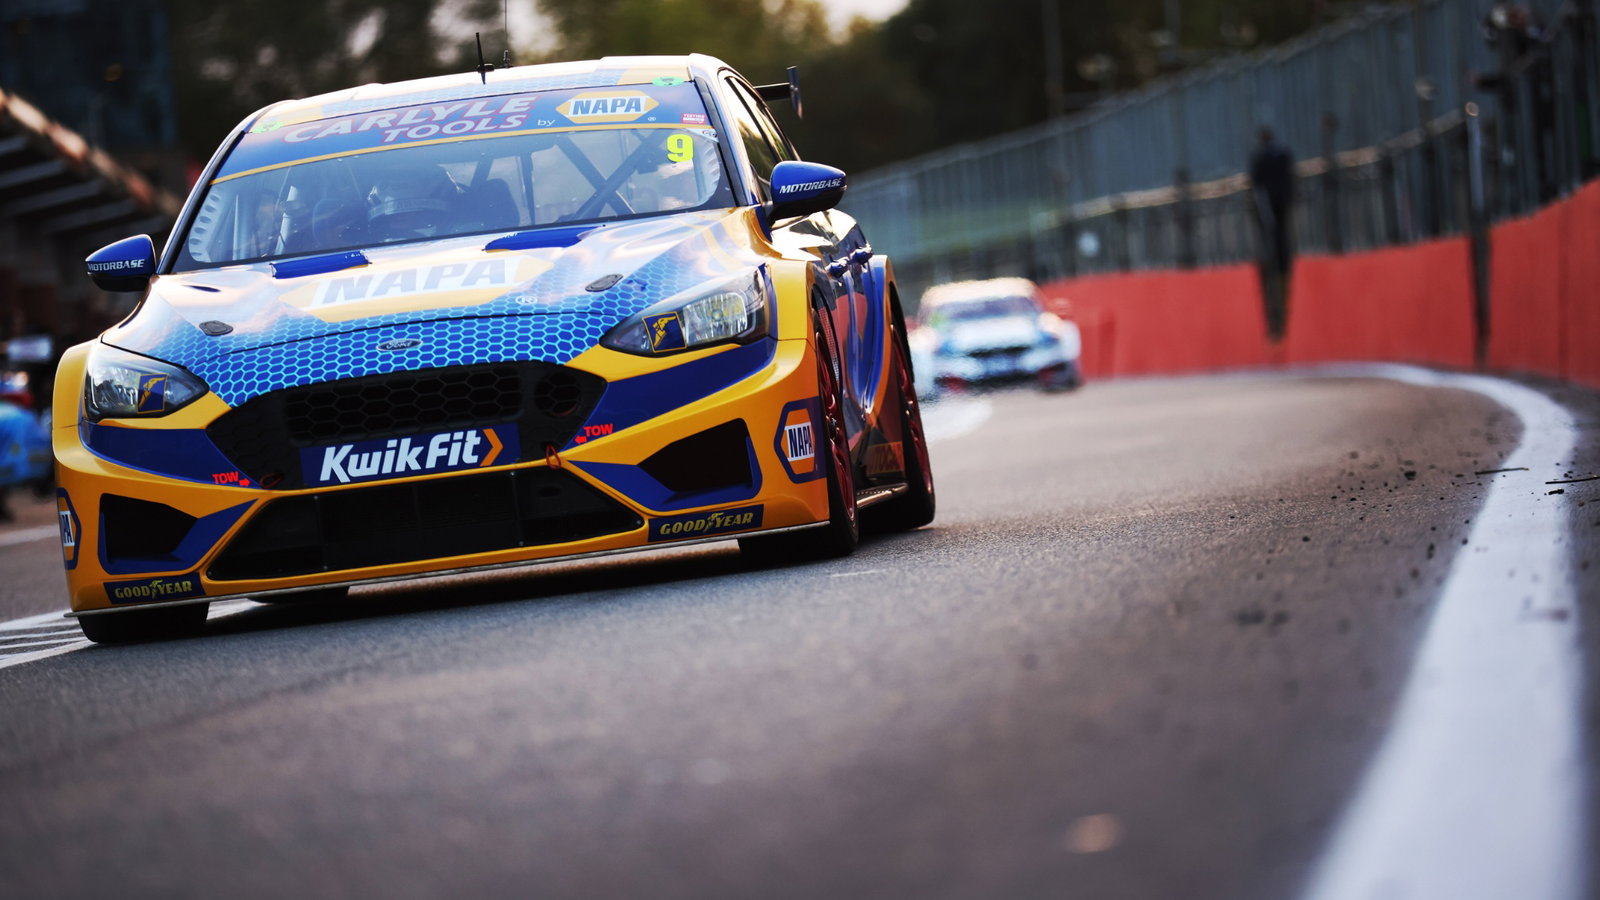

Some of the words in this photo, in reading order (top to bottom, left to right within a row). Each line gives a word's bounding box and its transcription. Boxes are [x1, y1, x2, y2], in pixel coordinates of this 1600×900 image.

[572, 98, 642, 115] NAPA
[284, 96, 538, 143] CARLYLE
[537, 119, 556, 127] by
[382, 114, 528, 143] TOOLS
[666, 133, 694, 163] 9
[779, 178, 842, 194] MOTORBASE
[87, 259, 145, 271] MOTORBASE
[321, 258, 507, 305] NAPA
[583, 423, 614, 437] TOW
[788, 424, 814, 458] NAPA
[212, 471, 239, 484] TOW
